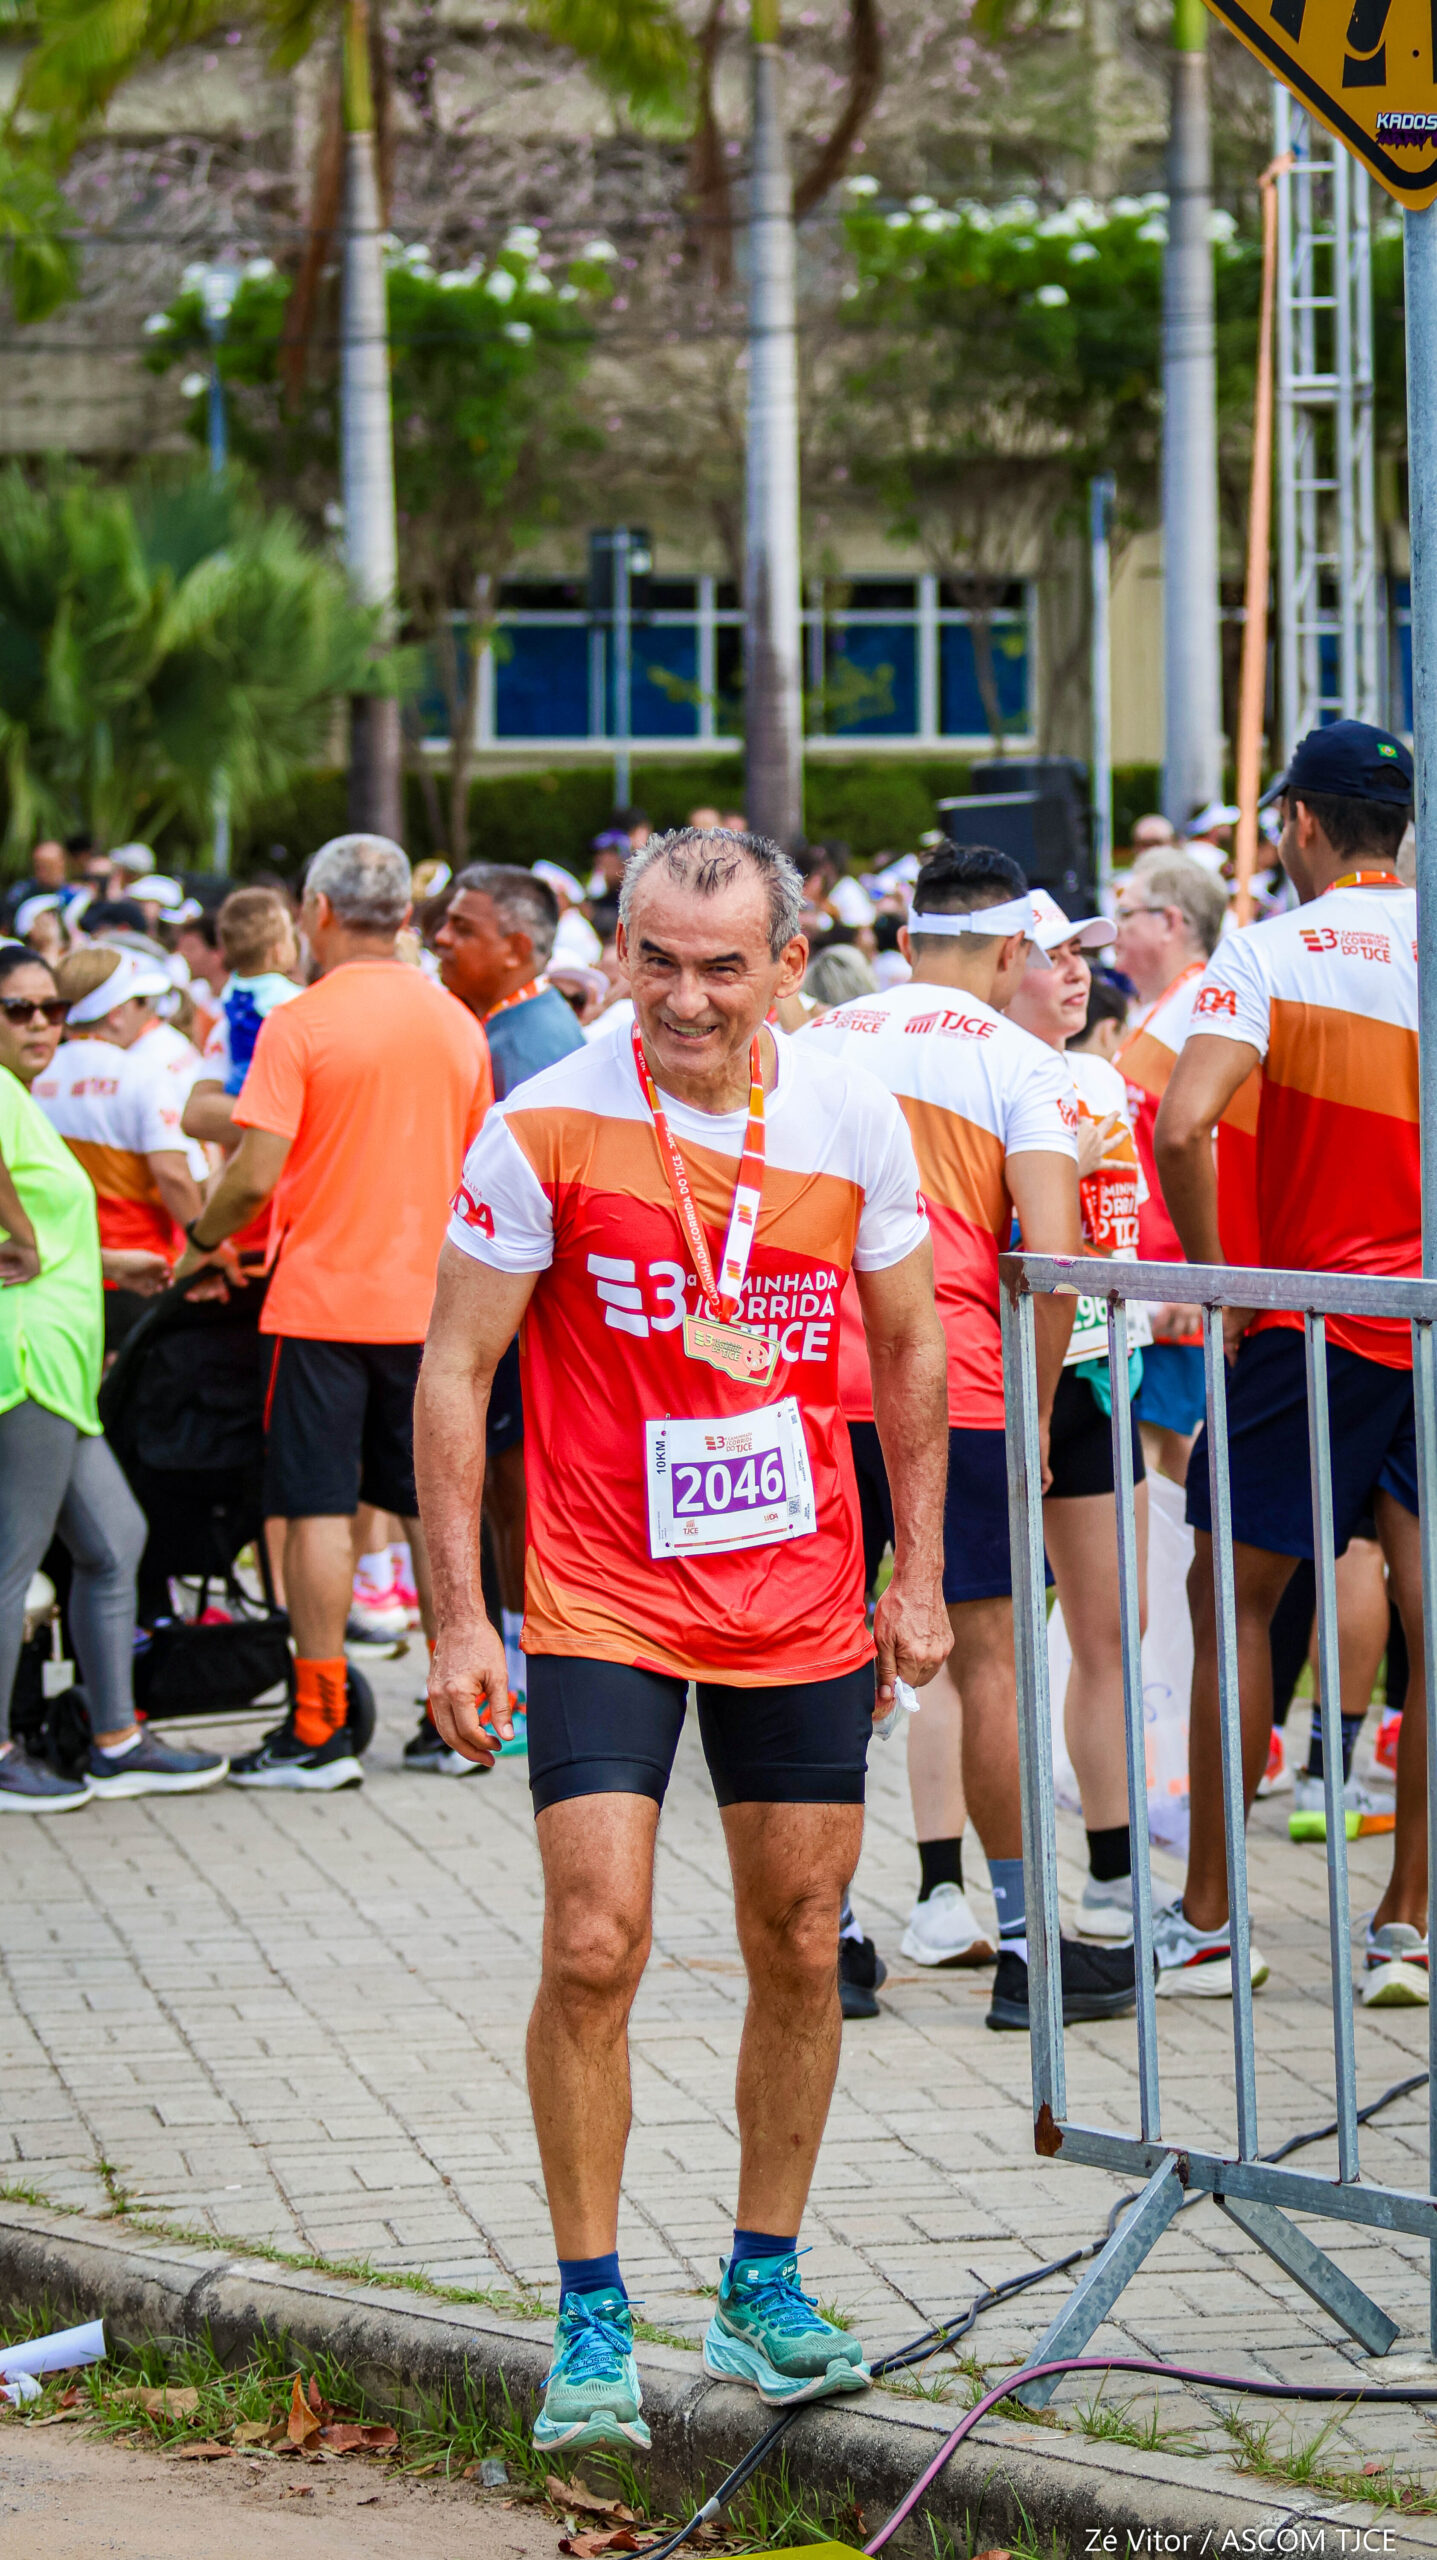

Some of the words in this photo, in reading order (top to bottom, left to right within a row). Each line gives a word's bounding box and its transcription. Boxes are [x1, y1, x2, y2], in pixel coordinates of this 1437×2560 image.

[1360, 946, 1392, 964] TJCE
[850, 1020, 883, 1034] TJCE
[940, 1010, 998, 1039] TJCE
[672, 1154, 686, 1177] TJCE
[678, 1178, 690, 1195] DO
[740, 1269, 838, 1294] MINHADA
[655, 1440, 666, 1475] 10KM
[736, 1442, 752, 1453] TJCE
[675, 1451, 783, 1514] 2046
